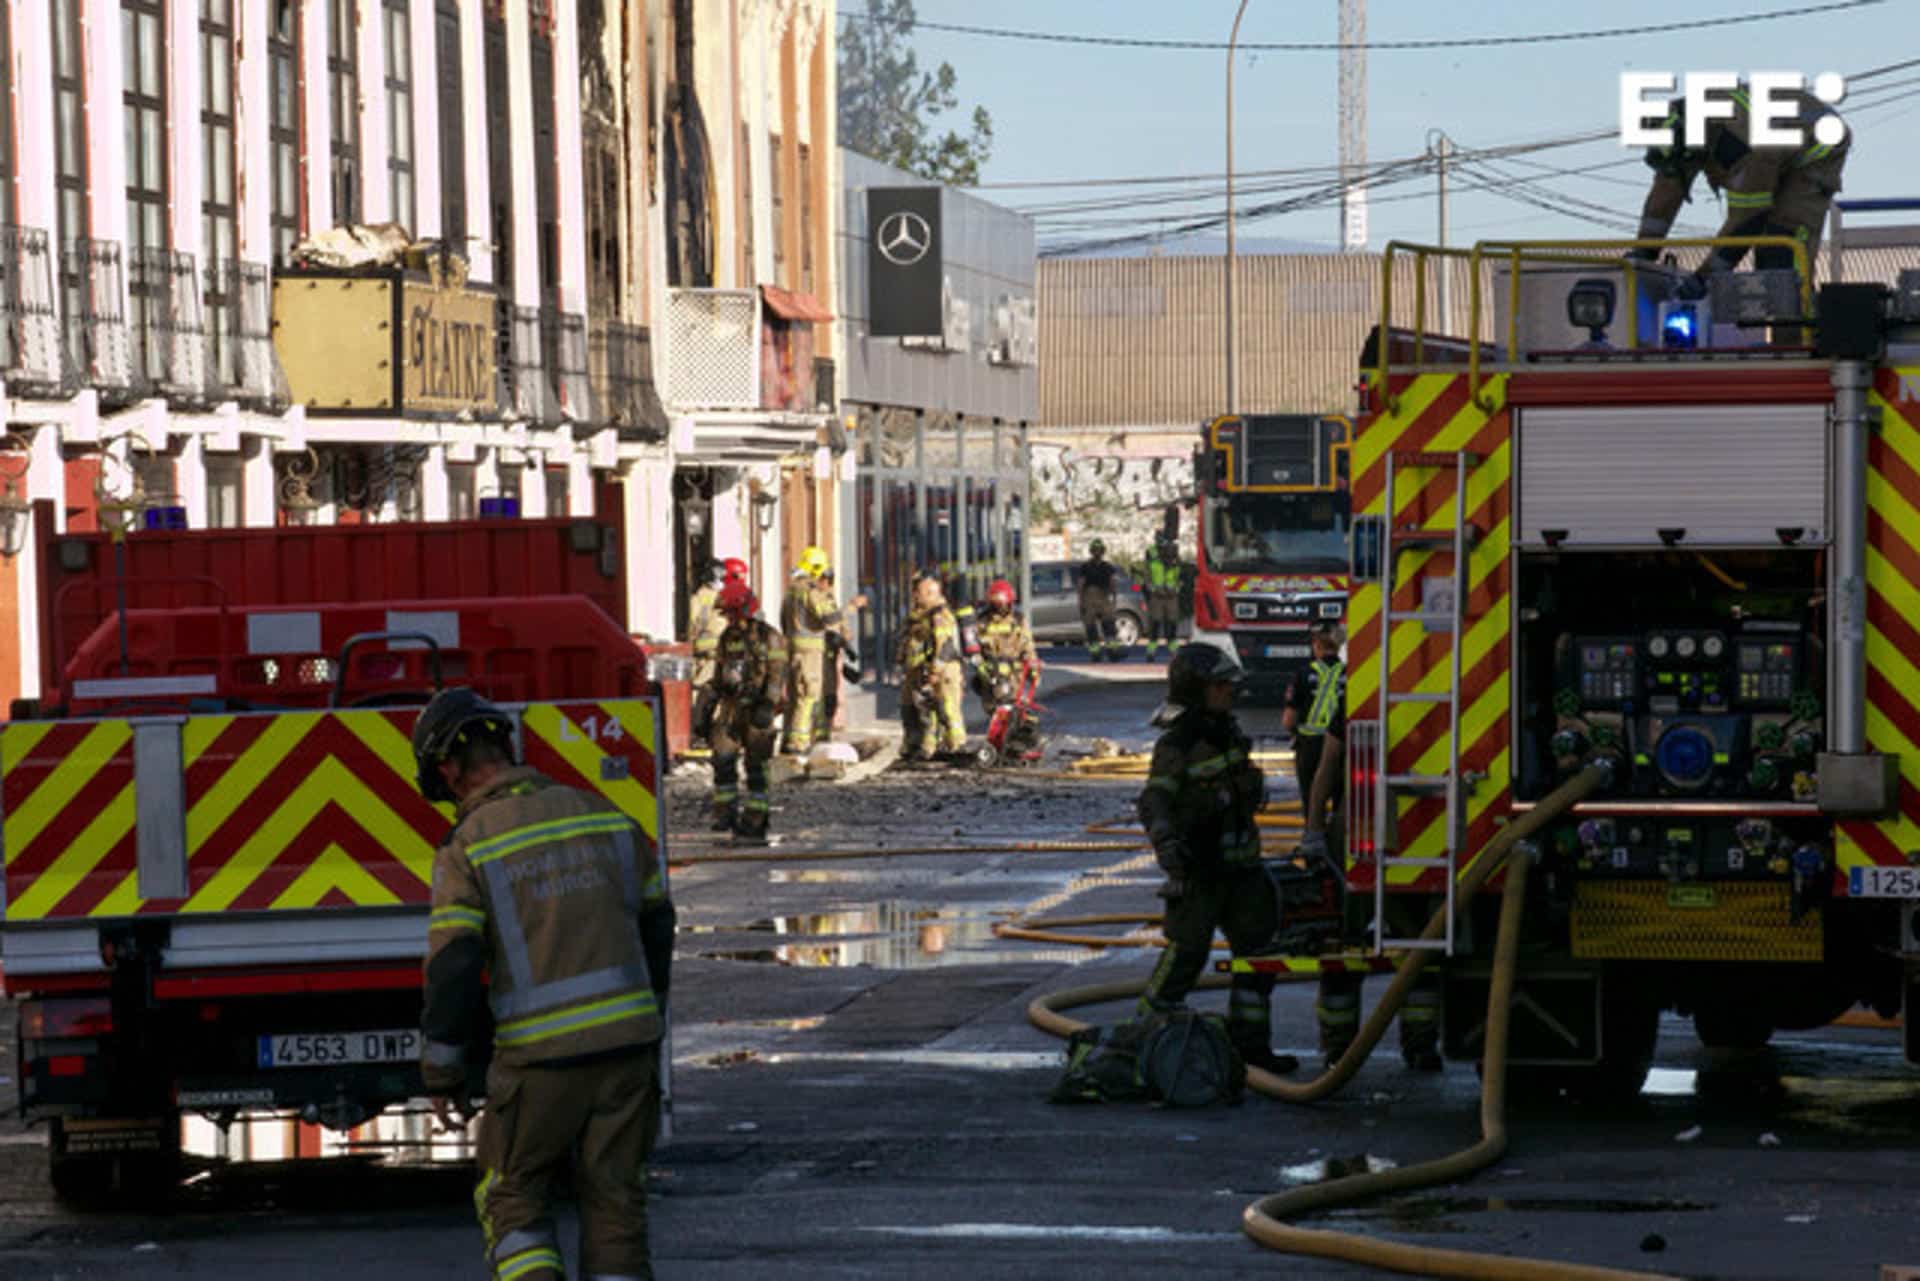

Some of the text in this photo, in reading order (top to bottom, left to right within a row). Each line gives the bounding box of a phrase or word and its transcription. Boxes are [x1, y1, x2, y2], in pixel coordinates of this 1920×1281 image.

[560, 715, 624, 741] L14
[277, 1034, 416, 1063] 4563 DWP
